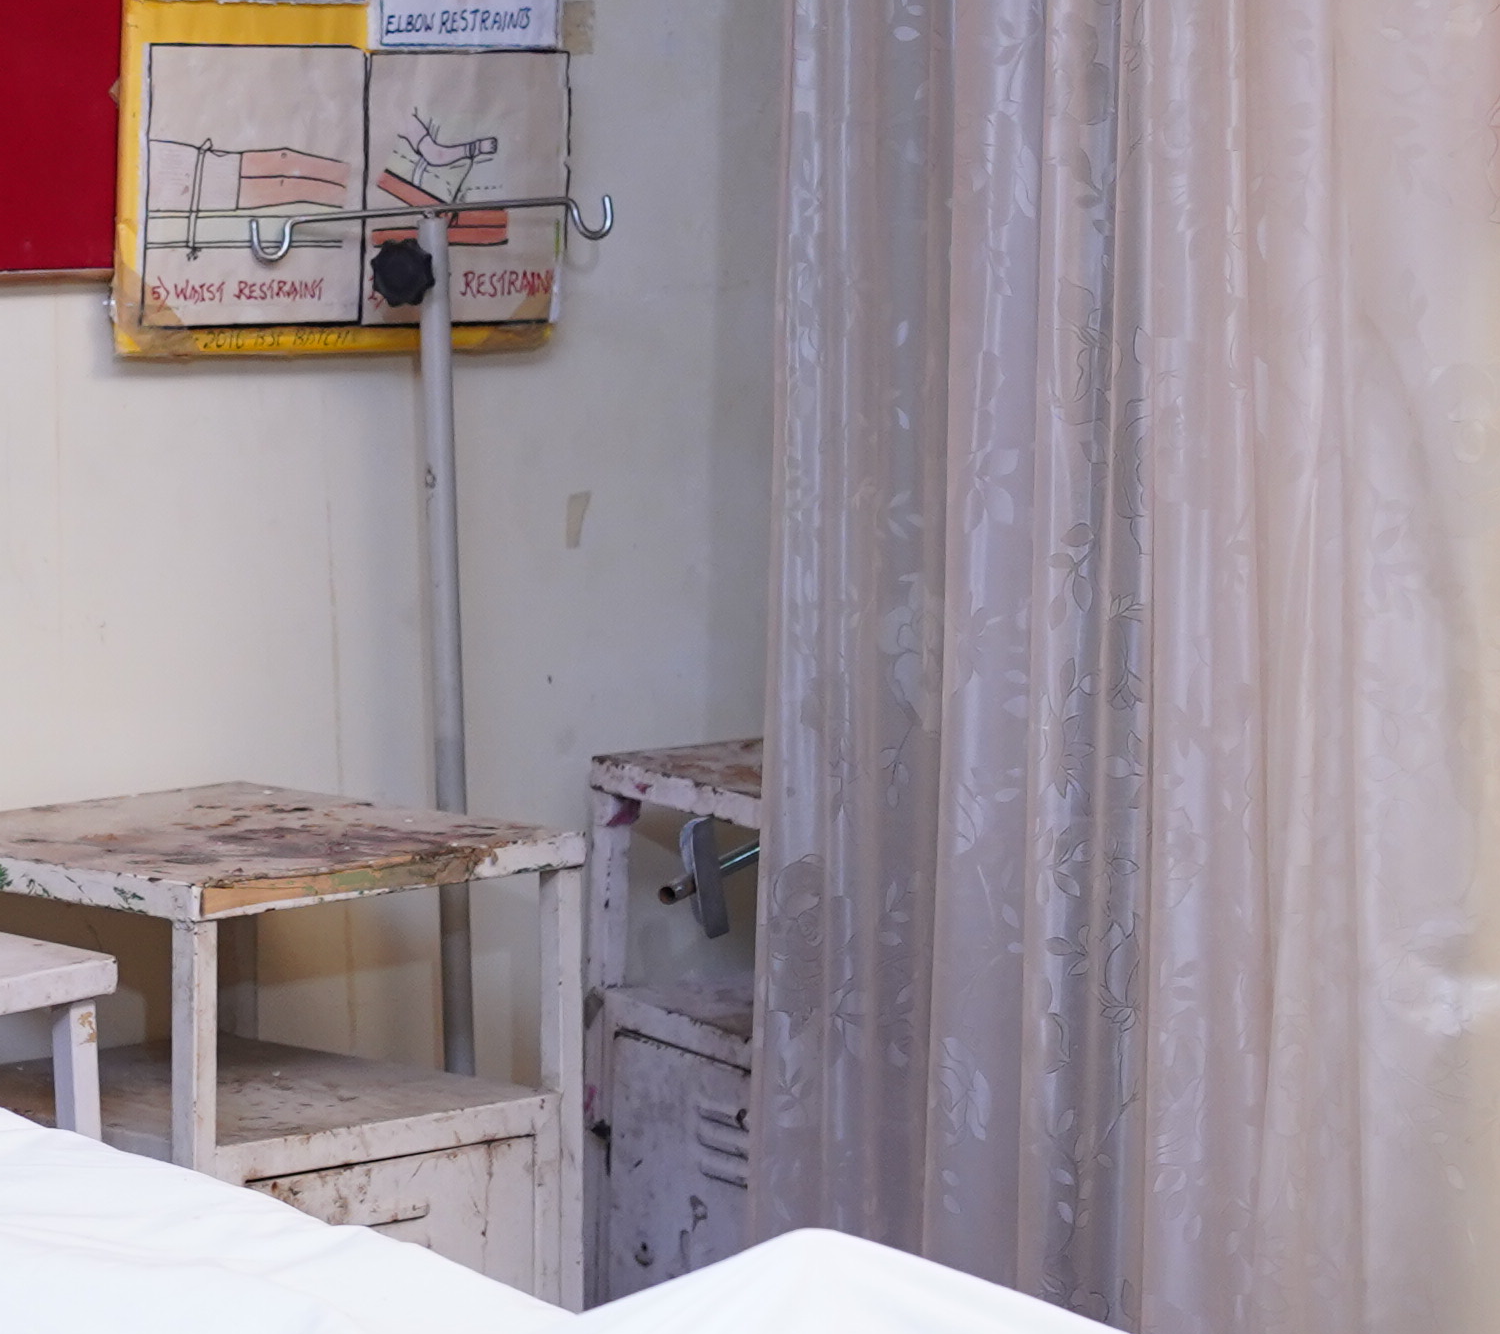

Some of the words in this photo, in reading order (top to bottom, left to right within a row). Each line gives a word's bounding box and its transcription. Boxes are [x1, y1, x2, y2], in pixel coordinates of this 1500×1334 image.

[384, 12, 436, 37] ELBOW
[173, 278, 227, 305] WAIST
[233, 277, 325, 302] RESTRAINT
